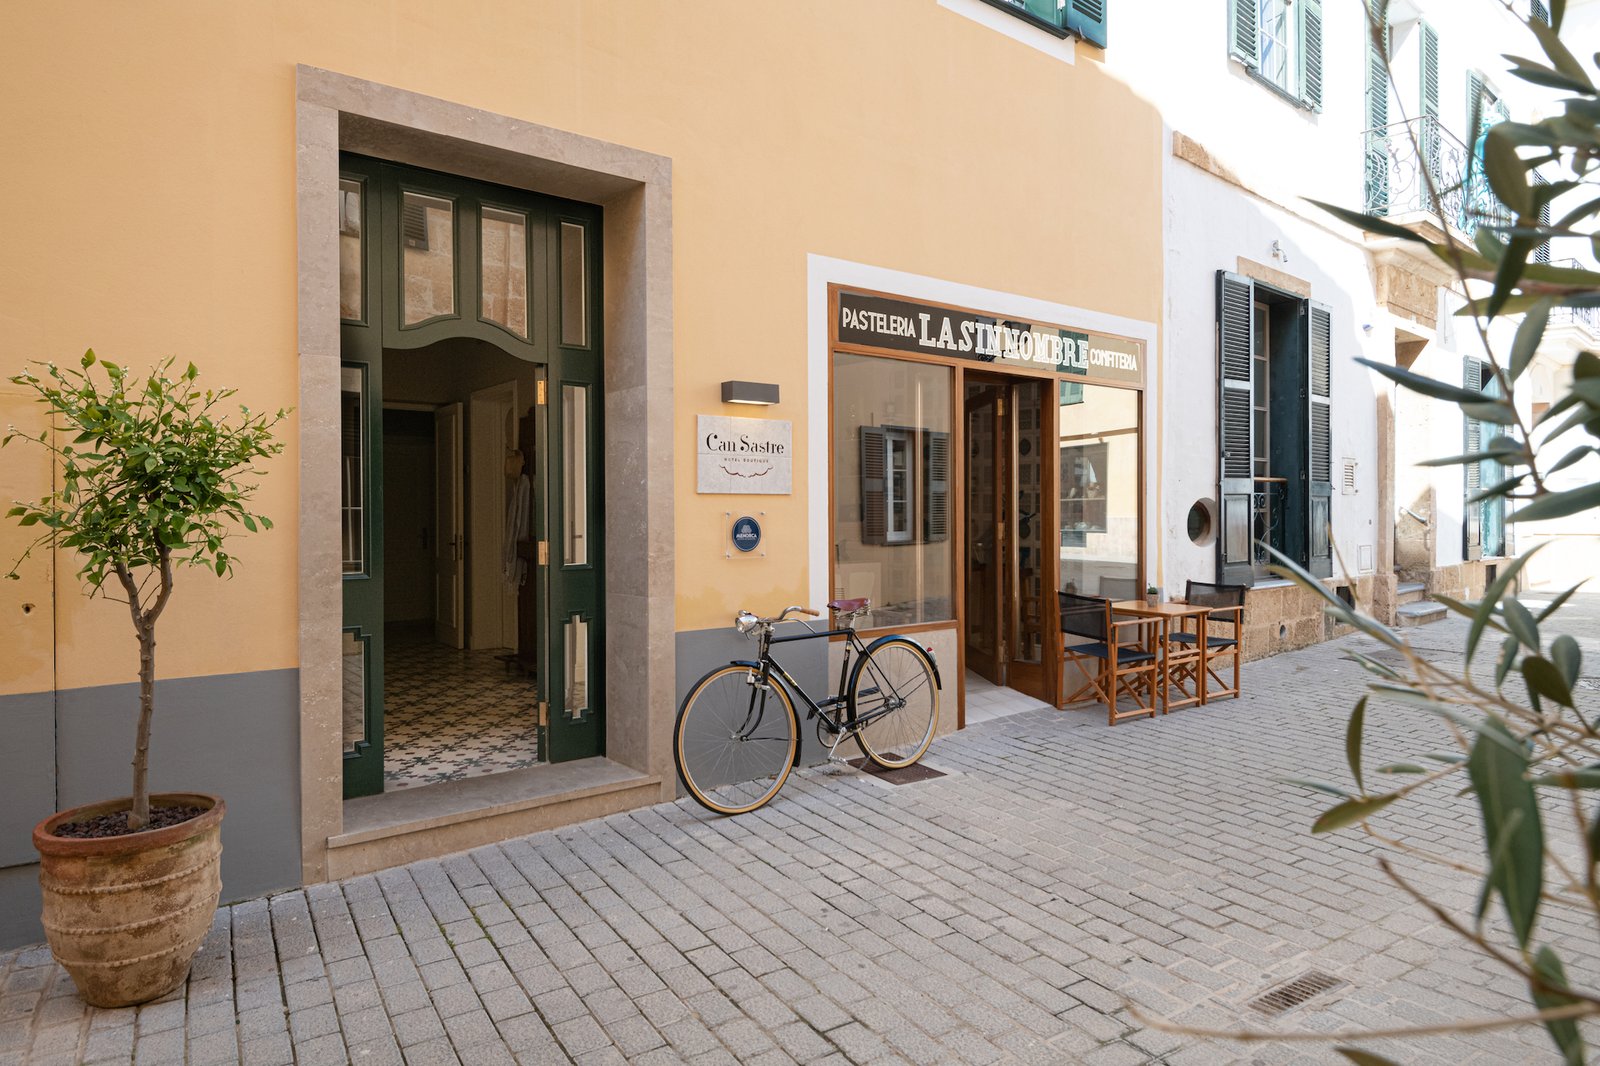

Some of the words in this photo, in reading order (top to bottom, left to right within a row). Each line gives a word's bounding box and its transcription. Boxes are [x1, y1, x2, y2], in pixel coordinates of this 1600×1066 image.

[841, 307, 916, 338] PASTELERIA
[918, 312, 958, 351] LA
[958, 320, 1002, 357] SIN
[1003, 326, 1089, 369] NOMBRE
[1089, 348, 1138, 371] CONFITERIA
[706, 432, 736, 452] Can
[740, 433, 785, 455] Sastre
